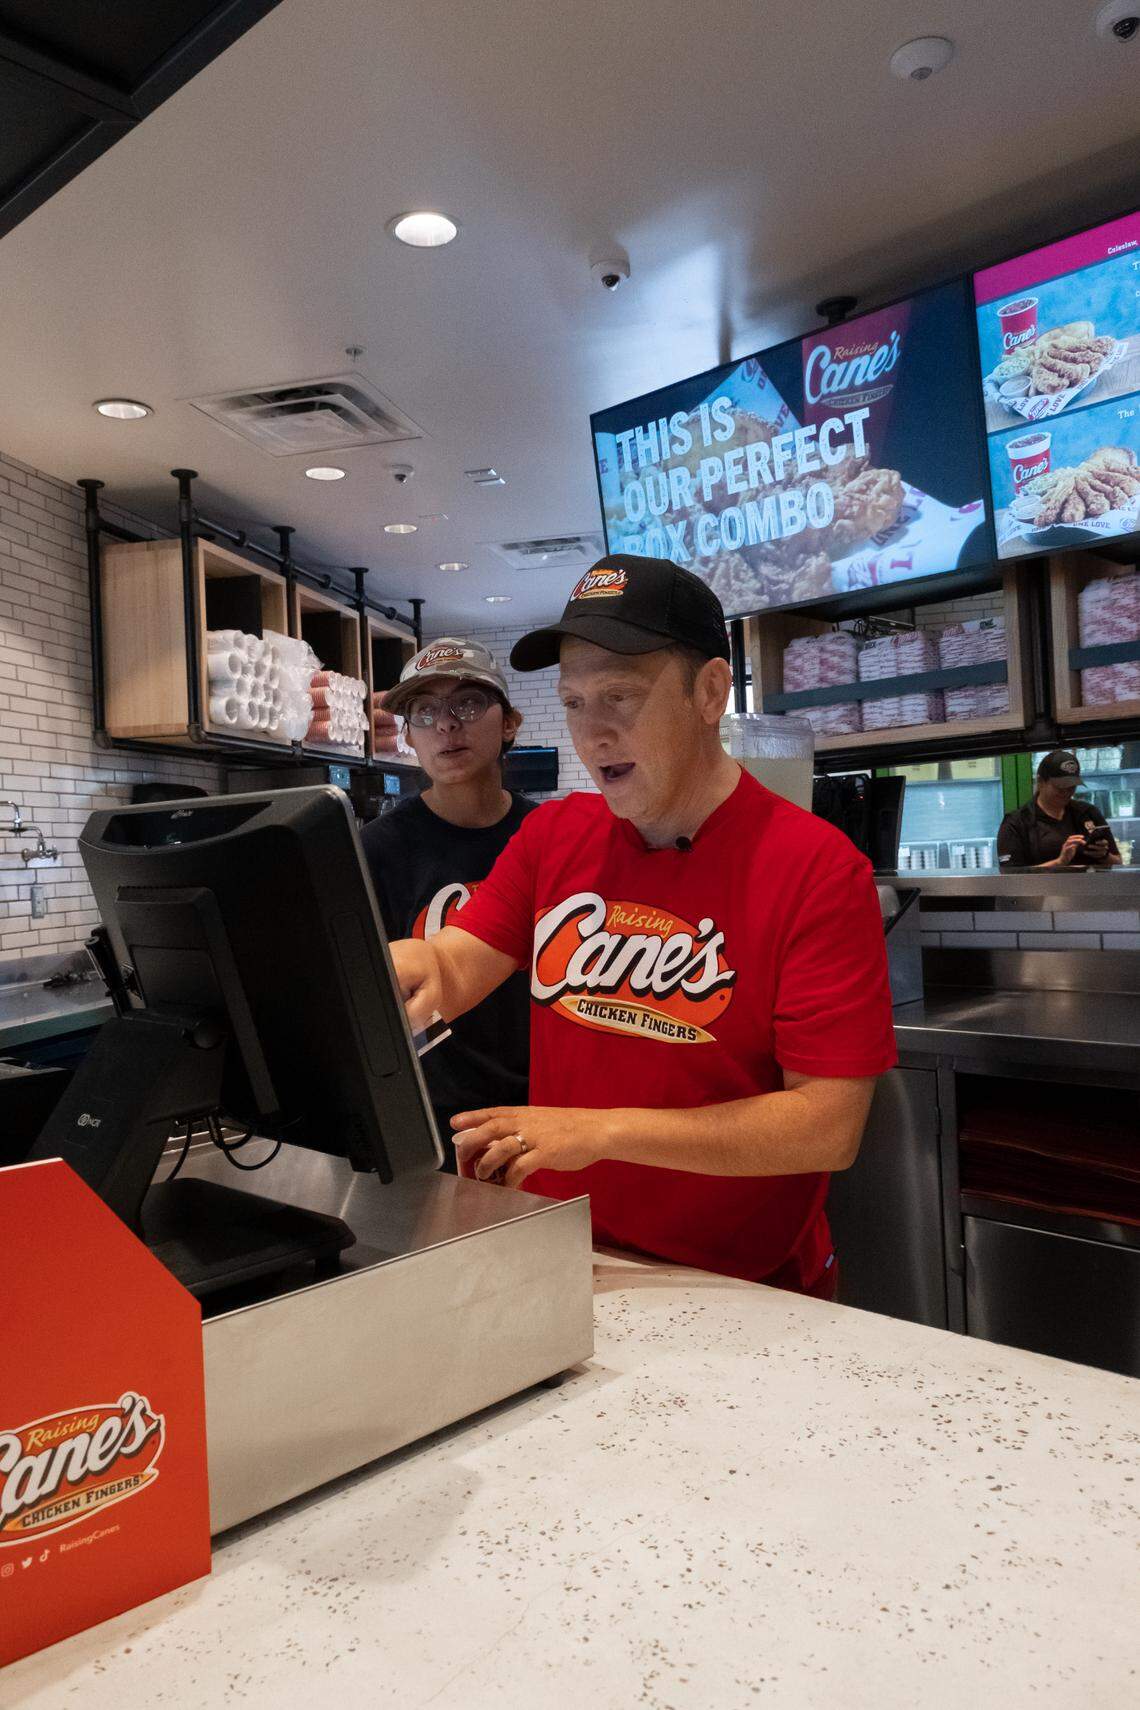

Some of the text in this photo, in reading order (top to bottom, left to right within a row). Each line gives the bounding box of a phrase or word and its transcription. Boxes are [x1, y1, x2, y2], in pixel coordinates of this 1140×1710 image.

[805, 330, 900, 404] Cane's
[834, 342, 879, 360] Raising
[616, 411, 693, 473] THIS
[700, 396, 736, 447] IS
[624, 408, 870, 523] OUR PERFECT
[1013, 457, 1049, 483] Cane's
[697, 481, 836, 557] COMBO
[607, 905, 674, 937] Raising
[531, 892, 736, 1000] Cane's
[576, 998, 698, 1042] CHICKEN FINGERS
[26, 1414, 99, 1452] Raising
[22, 1474, 140, 1528] CHICKEN FINGERS
[59, 1523, 120, 1553] RaisingCanes
